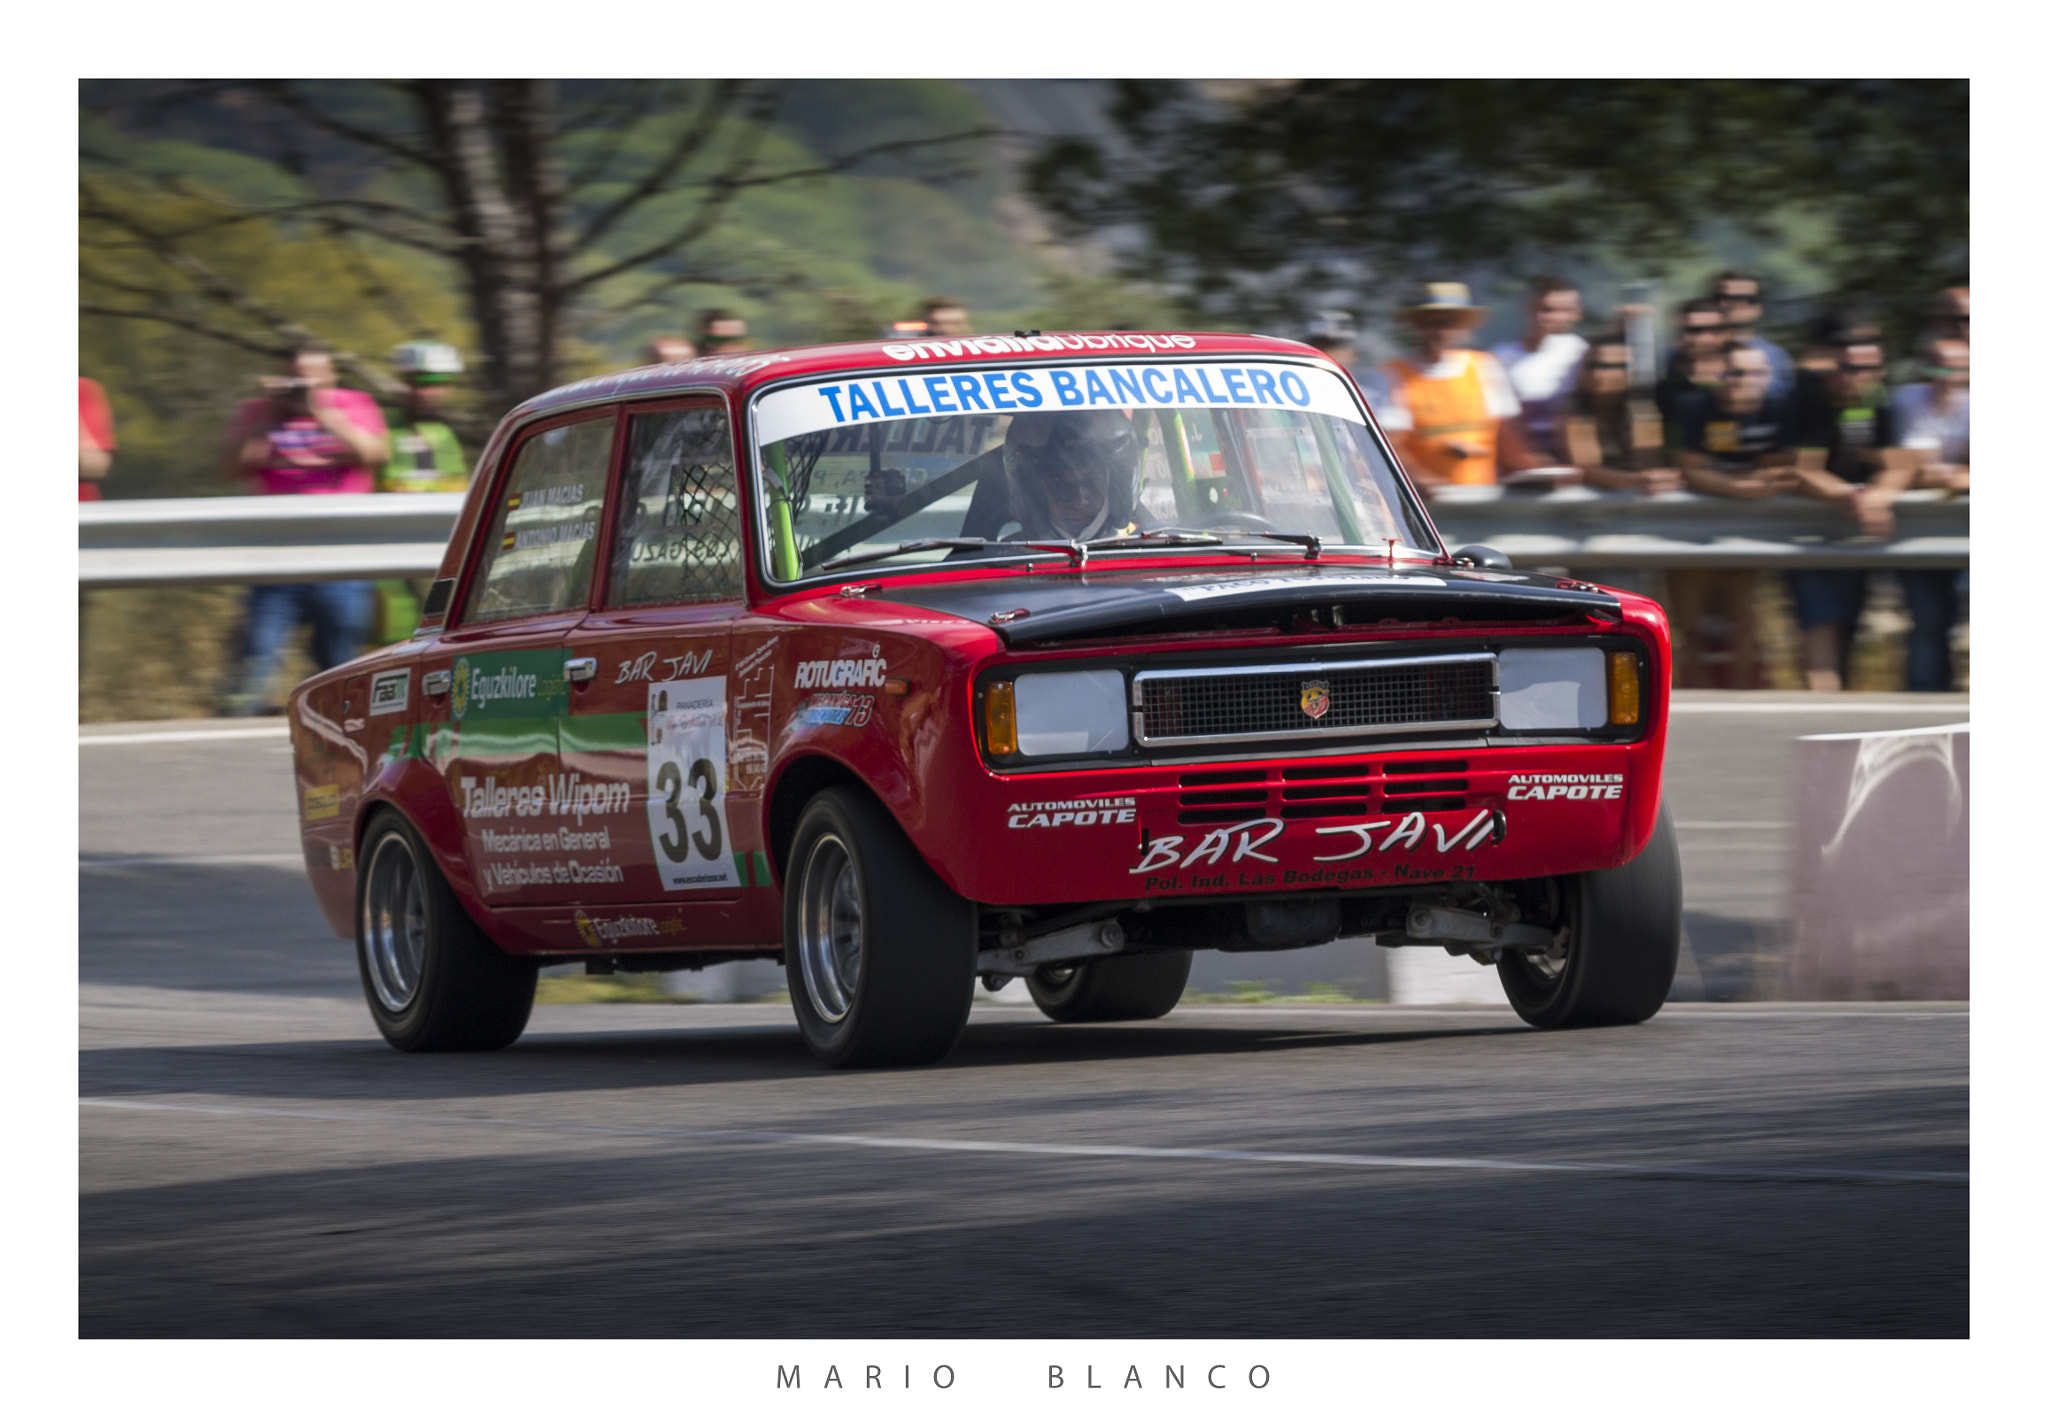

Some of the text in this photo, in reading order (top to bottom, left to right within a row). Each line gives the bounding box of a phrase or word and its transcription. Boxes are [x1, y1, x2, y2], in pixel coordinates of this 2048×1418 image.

[818, 371, 1043, 423] TALLERES
[1049, 366, 1311, 407] BANCALERO
[514, 526, 558, 548] ANTONIO
[614, 651, 657, 684] BAR
[661, 649, 713, 682] JAVI
[794, 658, 888, 689] ROTUGRAFIC
[470, 666, 537, 709] Eguzkilore
[1507, 774, 1624, 784] AUTOMOVILES
[1507, 785, 1624, 800] CAPOTE
[460, 772, 631, 827] Talleres Wipom
[655, 758, 722, 863] 33
[1007, 797, 1136, 812] AUTOMOVILES
[1008, 808, 1137, 828] CAPOTE
[481, 825, 611, 853] Mecánica en General
[1129, 809, 1495, 875] BAR JAVI
[483, 857, 625, 892] y Vehículos de Ocasión
[1145, 876, 1183, 891] Pol.
[1191, 874, 1230, 889] Ind.
[1239, 872, 1276, 886] Las
[1283, 869, 1374, 884] Bodegas
[1394, 863, 1444, 879] Nave
[1451, 865, 1475, 879] 21
